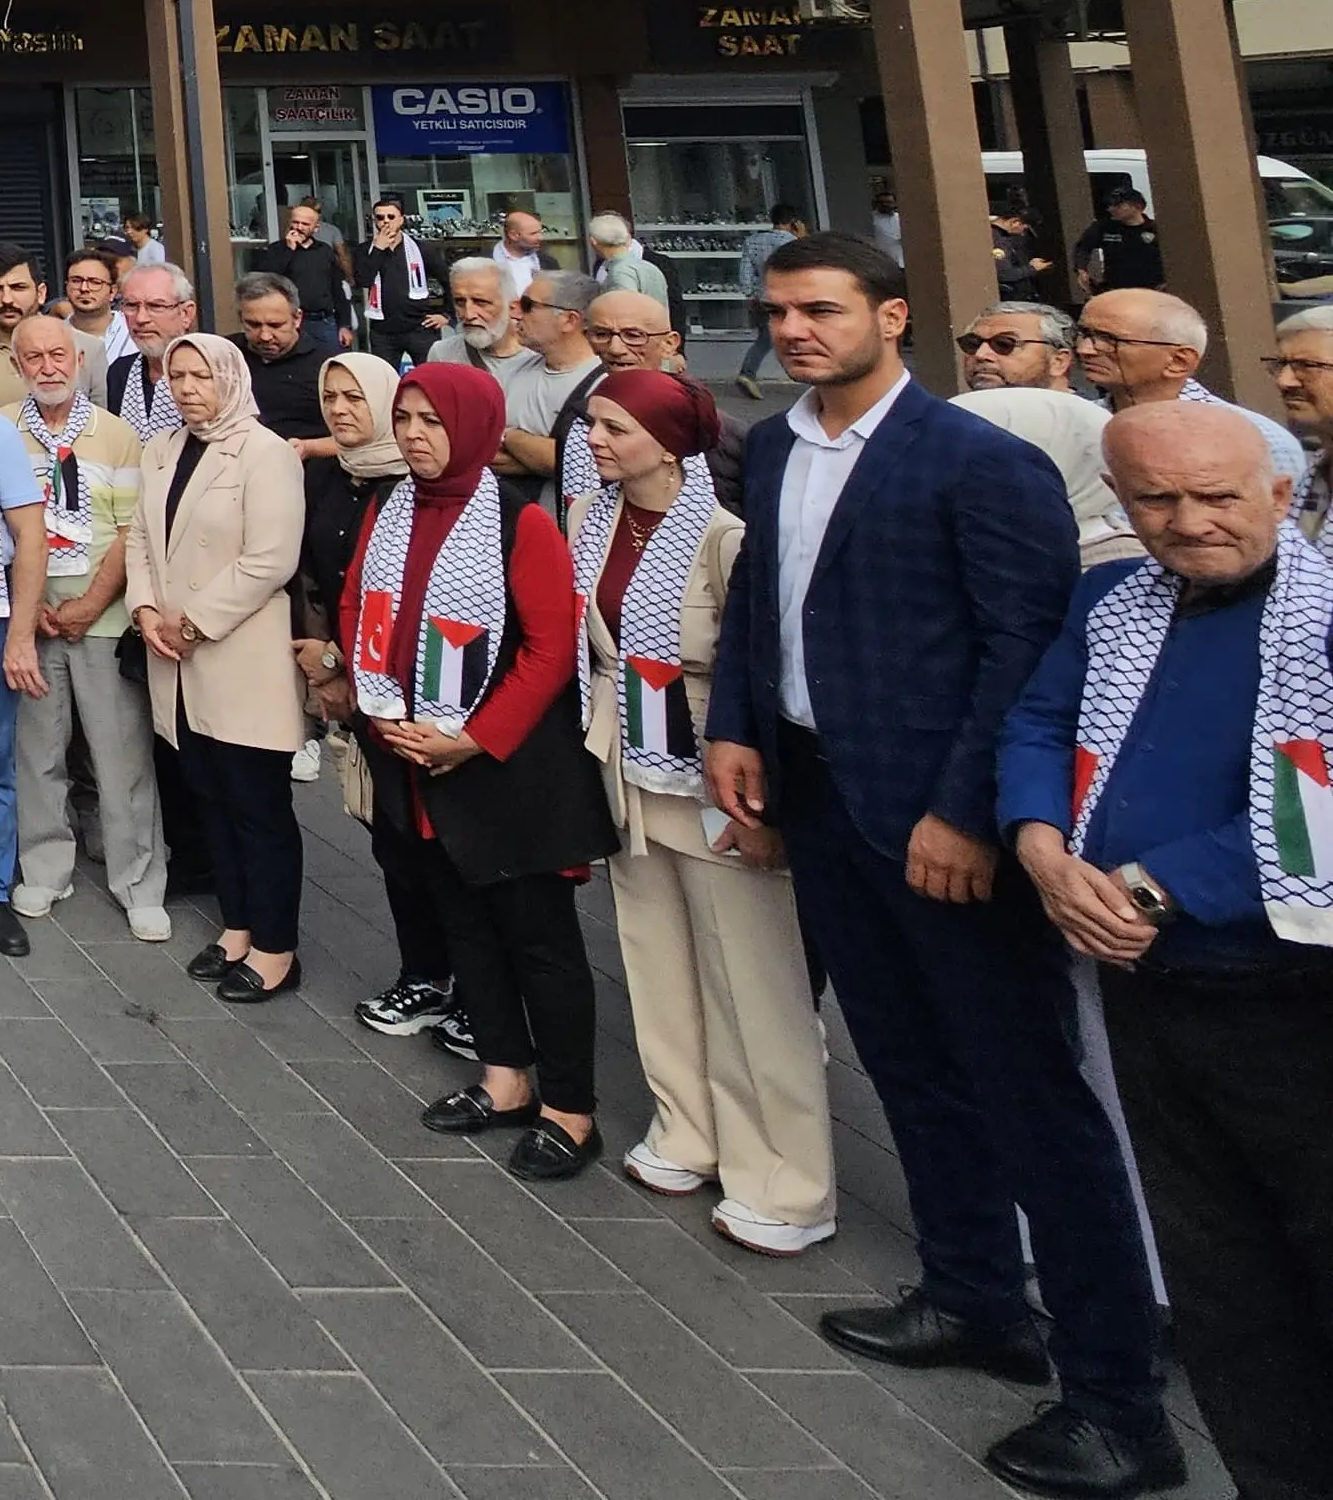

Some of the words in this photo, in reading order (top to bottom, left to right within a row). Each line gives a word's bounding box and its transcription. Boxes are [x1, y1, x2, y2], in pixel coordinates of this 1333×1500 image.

[216, 23, 358, 53] ZAMAN
[373, 22, 486, 52] SAAT
[717, 33, 802, 57] SAAT
[284, 87, 340, 101] ZAMAN
[392, 87, 536, 116] CASIO
[413, 117, 457, 130] YETKİLİ
[459, 119, 527, 130] SATICISIDIR
